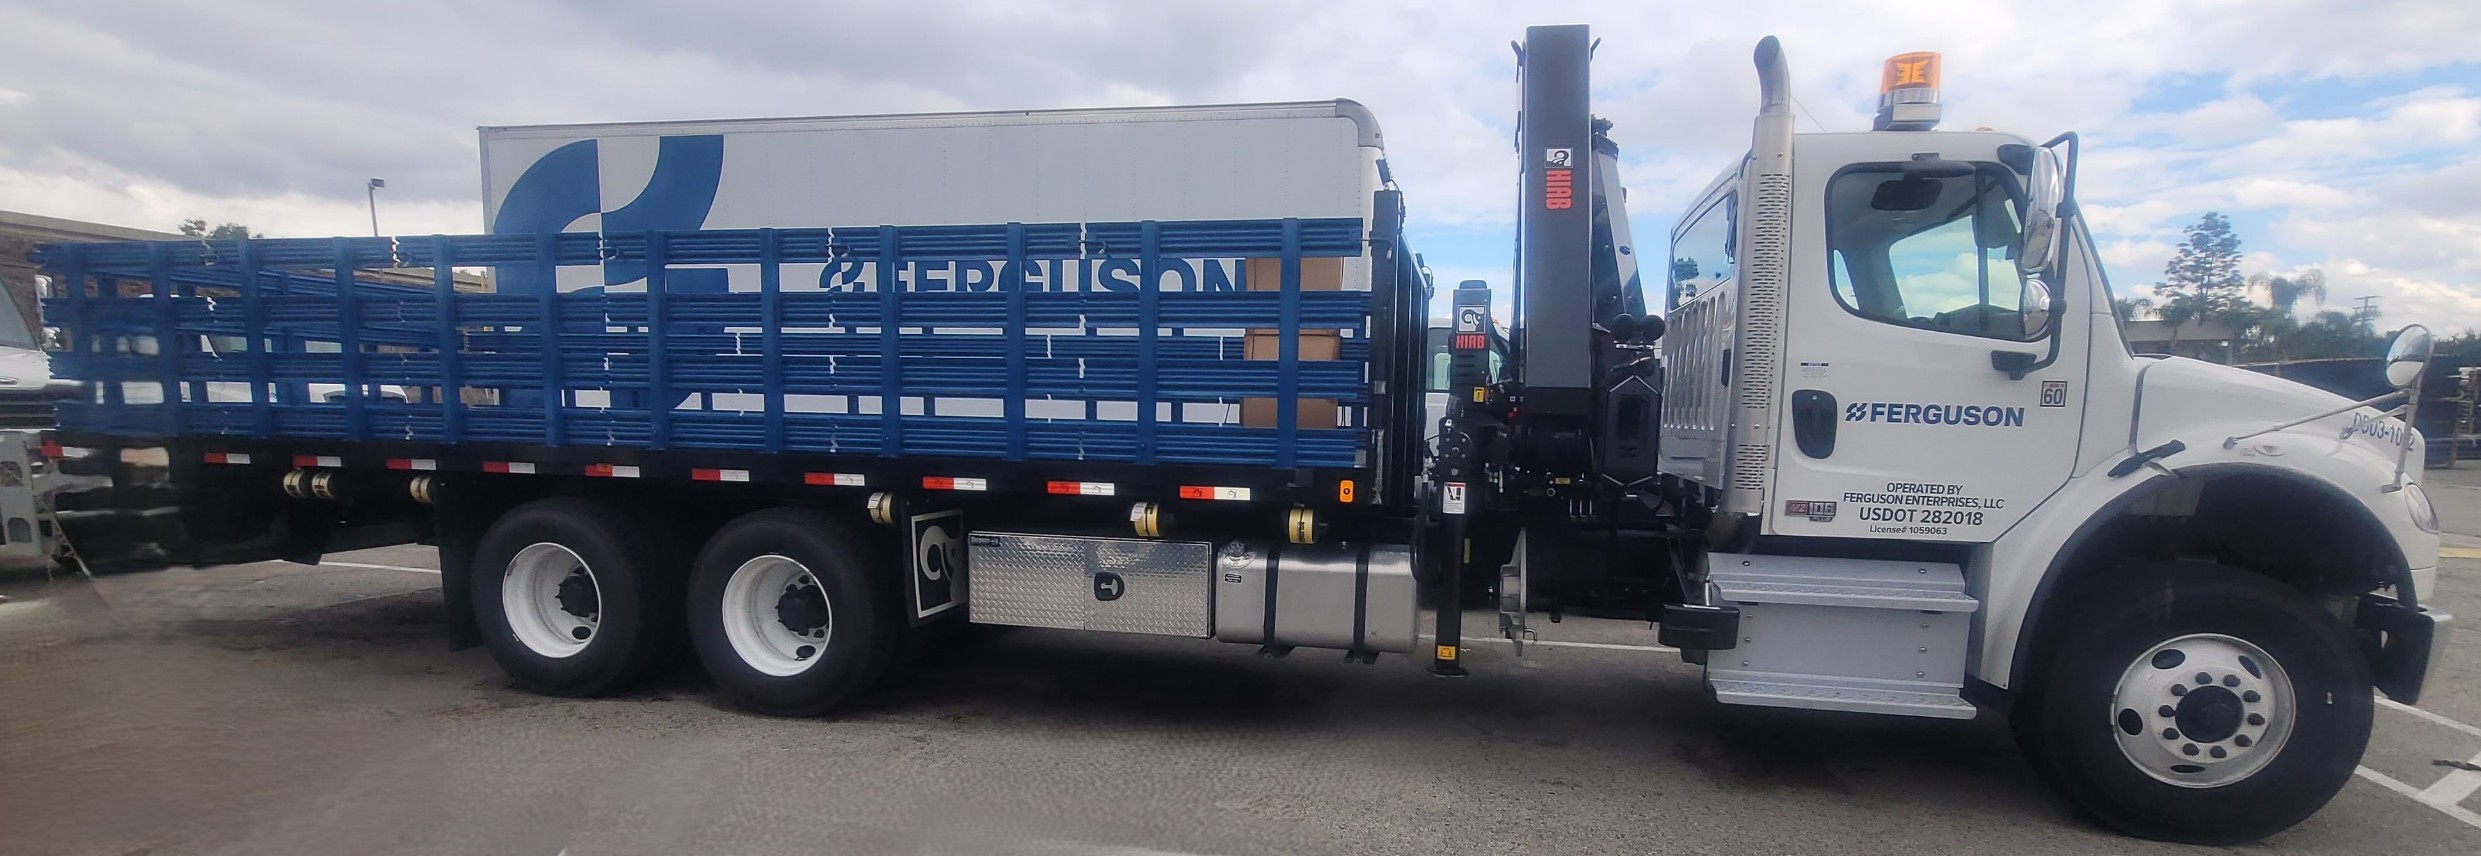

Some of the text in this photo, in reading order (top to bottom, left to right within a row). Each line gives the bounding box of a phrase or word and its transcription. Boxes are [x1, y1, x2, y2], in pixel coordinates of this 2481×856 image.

[1546, 170, 1572, 209] HIAB
[877, 259, 1246, 292] ERUSON
[1456, 335, 1485, 349] HIAB
[2043, 388, 2063, 405] 60
[1869, 402, 2025, 427] FERGUSON
[1886, 482, 1963, 495] OPERATED BY
[1843, 492, 2005, 509] FERGUSON ENTERPRISES, LLC
[1859, 507, 1984, 526] USDOT 282018
[1869, 525, 1948, 535] License# 1059063
